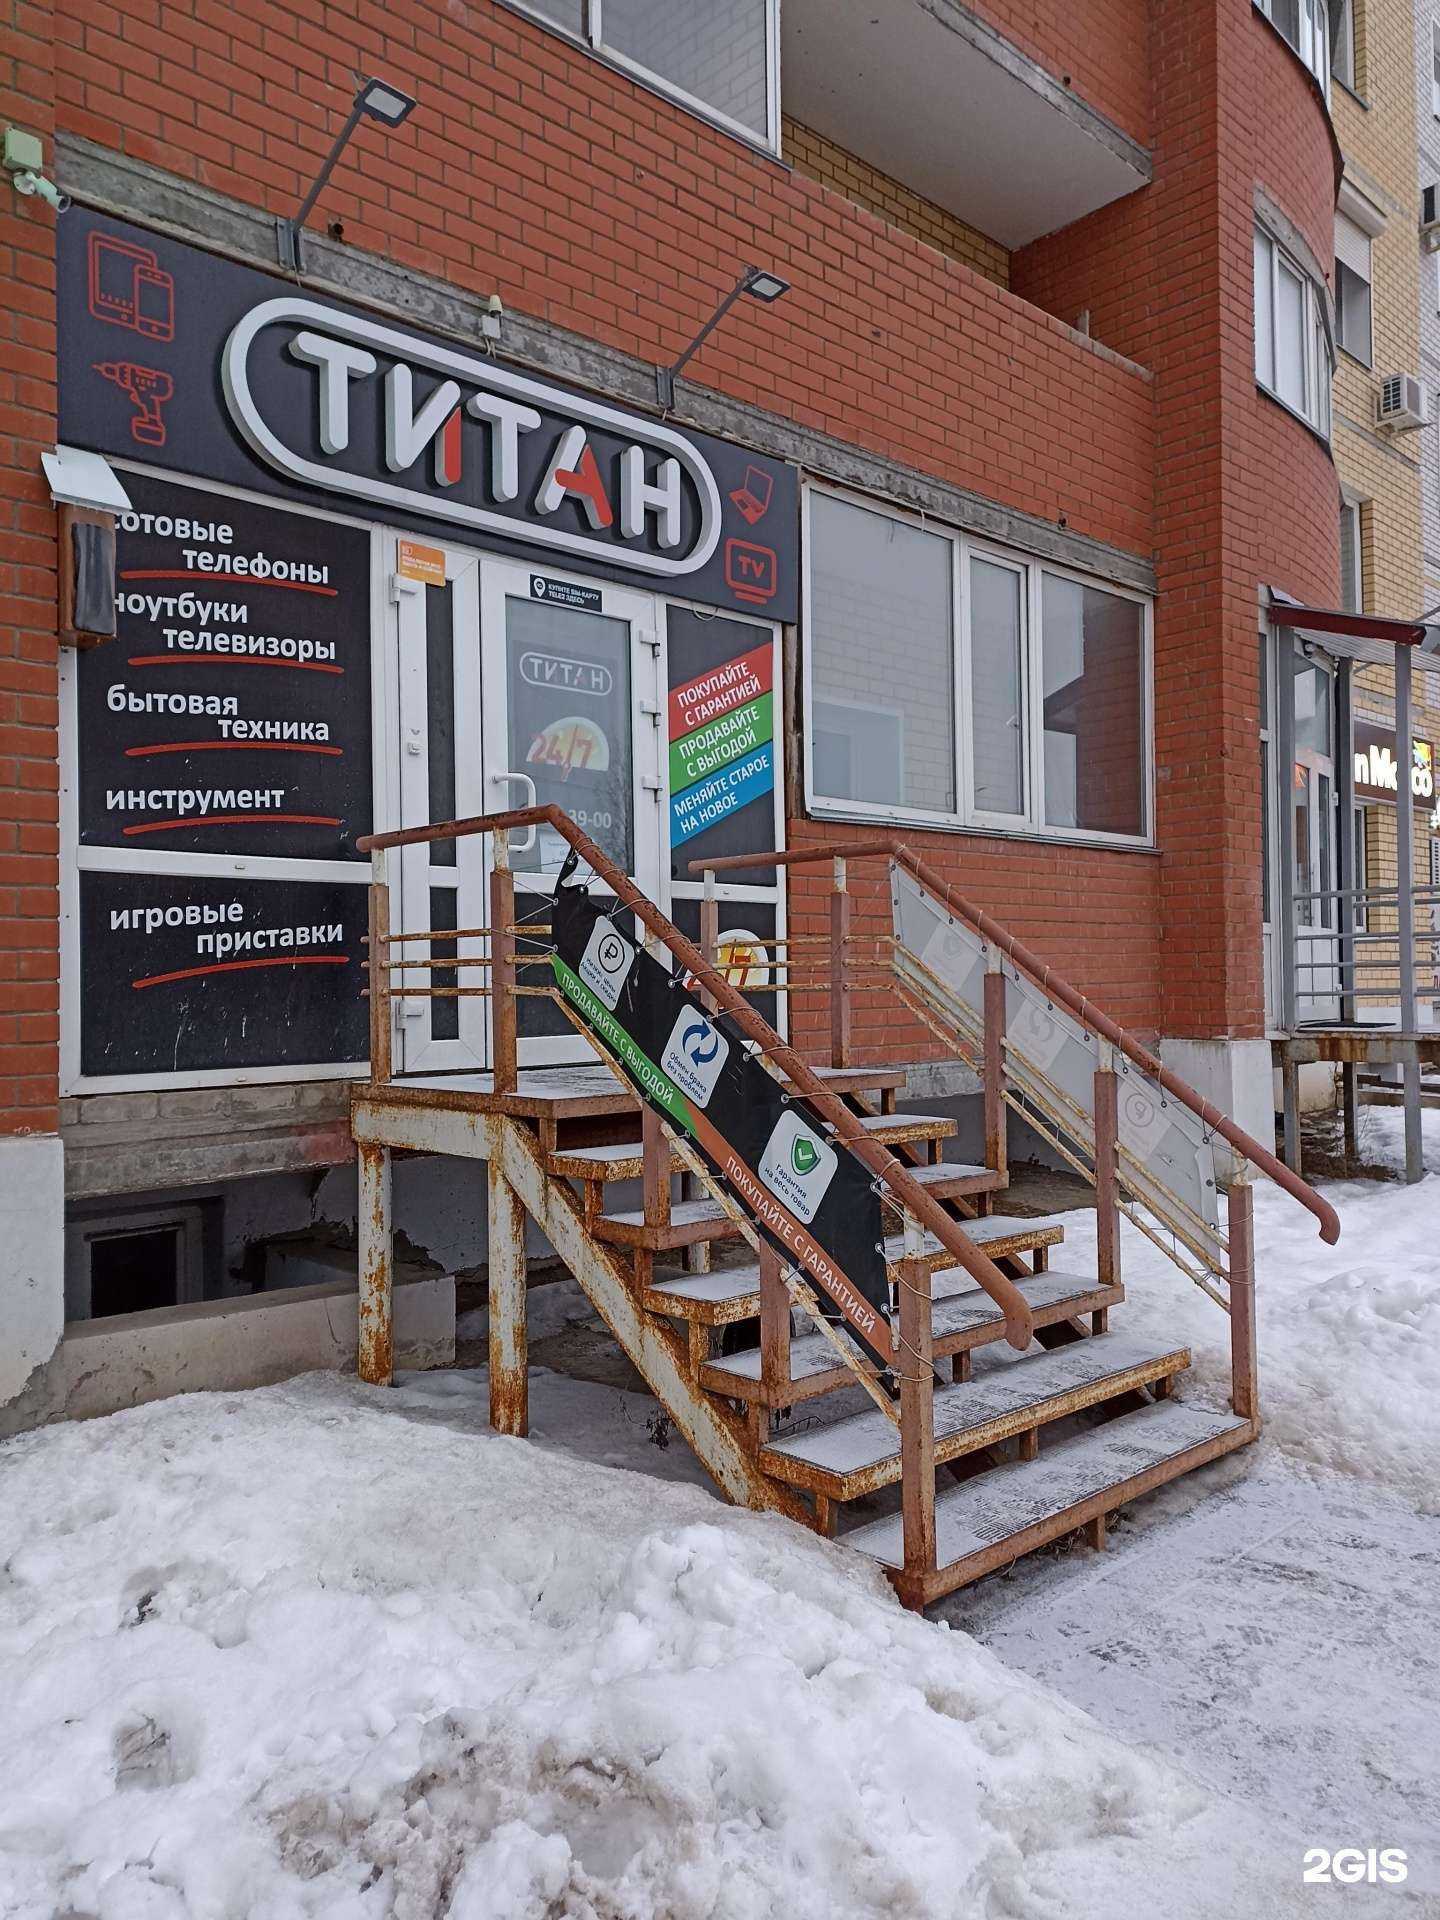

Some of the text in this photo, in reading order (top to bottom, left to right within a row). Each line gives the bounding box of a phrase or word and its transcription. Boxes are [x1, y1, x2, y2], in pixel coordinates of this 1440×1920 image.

[288, 331, 681, 549] ТИТАН
[182, 549, 329, 584] телефоны
[738, 555, 765, 578] TV
[163, 628, 335, 662] телевизоры
[529, 658, 604, 691] ТИТАН
[677, 661, 751, 708] ПОКУПАЙТЕ
[107, 684, 238, 716] бытовая
[684, 674, 761, 726] С ГАРАНТИЕЙ
[218, 718, 329, 741] техника
[679, 706, 760, 759] ПРОДАВАЙТЕ
[530, 726, 595, 782] 24/7
[687, 727, 757, 777] С ВЫГОДОЙ
[106, 789, 285, 815] инструмент
[674, 755, 770, 817] МЕНЯЙТЕ СТАРОЕ
[680, 791, 738, 834] НА НОВОЕ
[110, 902, 243, 934] игровые
[197, 924, 343, 958] приставки
[562, 972, 674, 1105] ПРОДАВАЙТЕ С ВЫГОДОЙ
[667, 1060, 703, 1100] без проблем
[670, 1052, 707, 1093] Обмен брака
[765, 1168, 810, 1216] на весь товар
[776, 1164, 807, 1199] Гарантия
[726, 1156, 875, 1333] ПОКУПАЙТЕ С ГАРАНТИЕЙ
